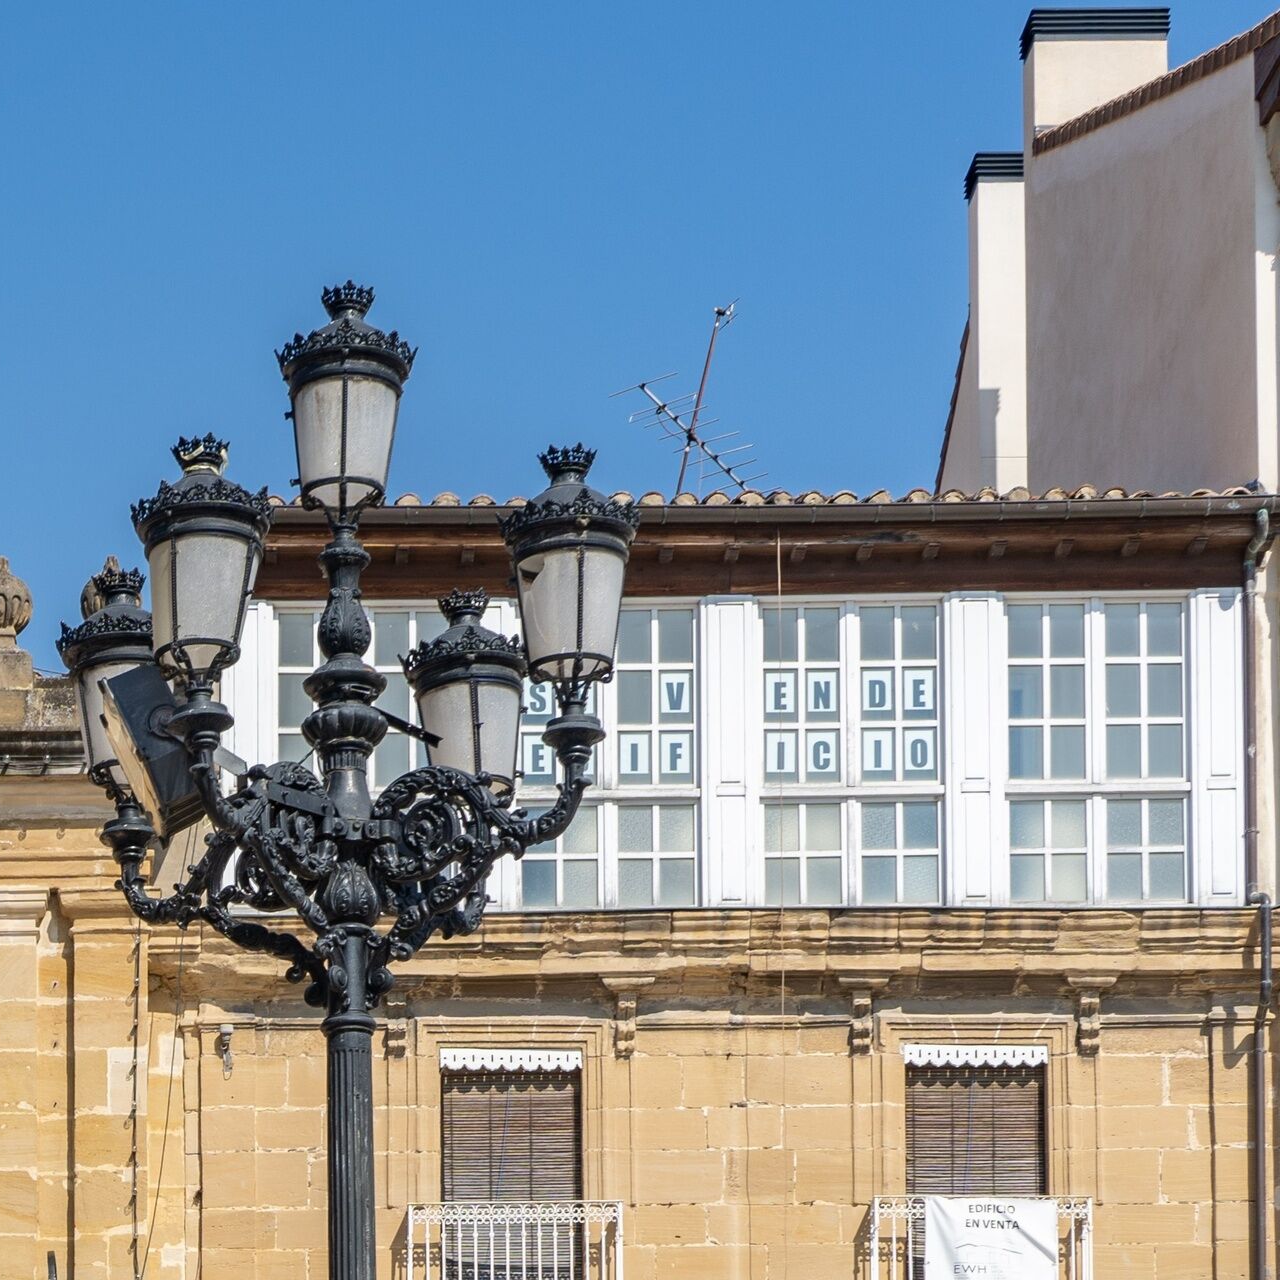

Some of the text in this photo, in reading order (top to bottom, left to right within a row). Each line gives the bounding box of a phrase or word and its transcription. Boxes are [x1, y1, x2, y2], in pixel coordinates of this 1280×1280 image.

[532, 738, 928, 773] EIFICIO
[968, 1204, 1016, 1214] EDIFICIO
[965, 1219, 1020, 1230] EN VENTA
[953, 1264, 987, 1274] EWH
